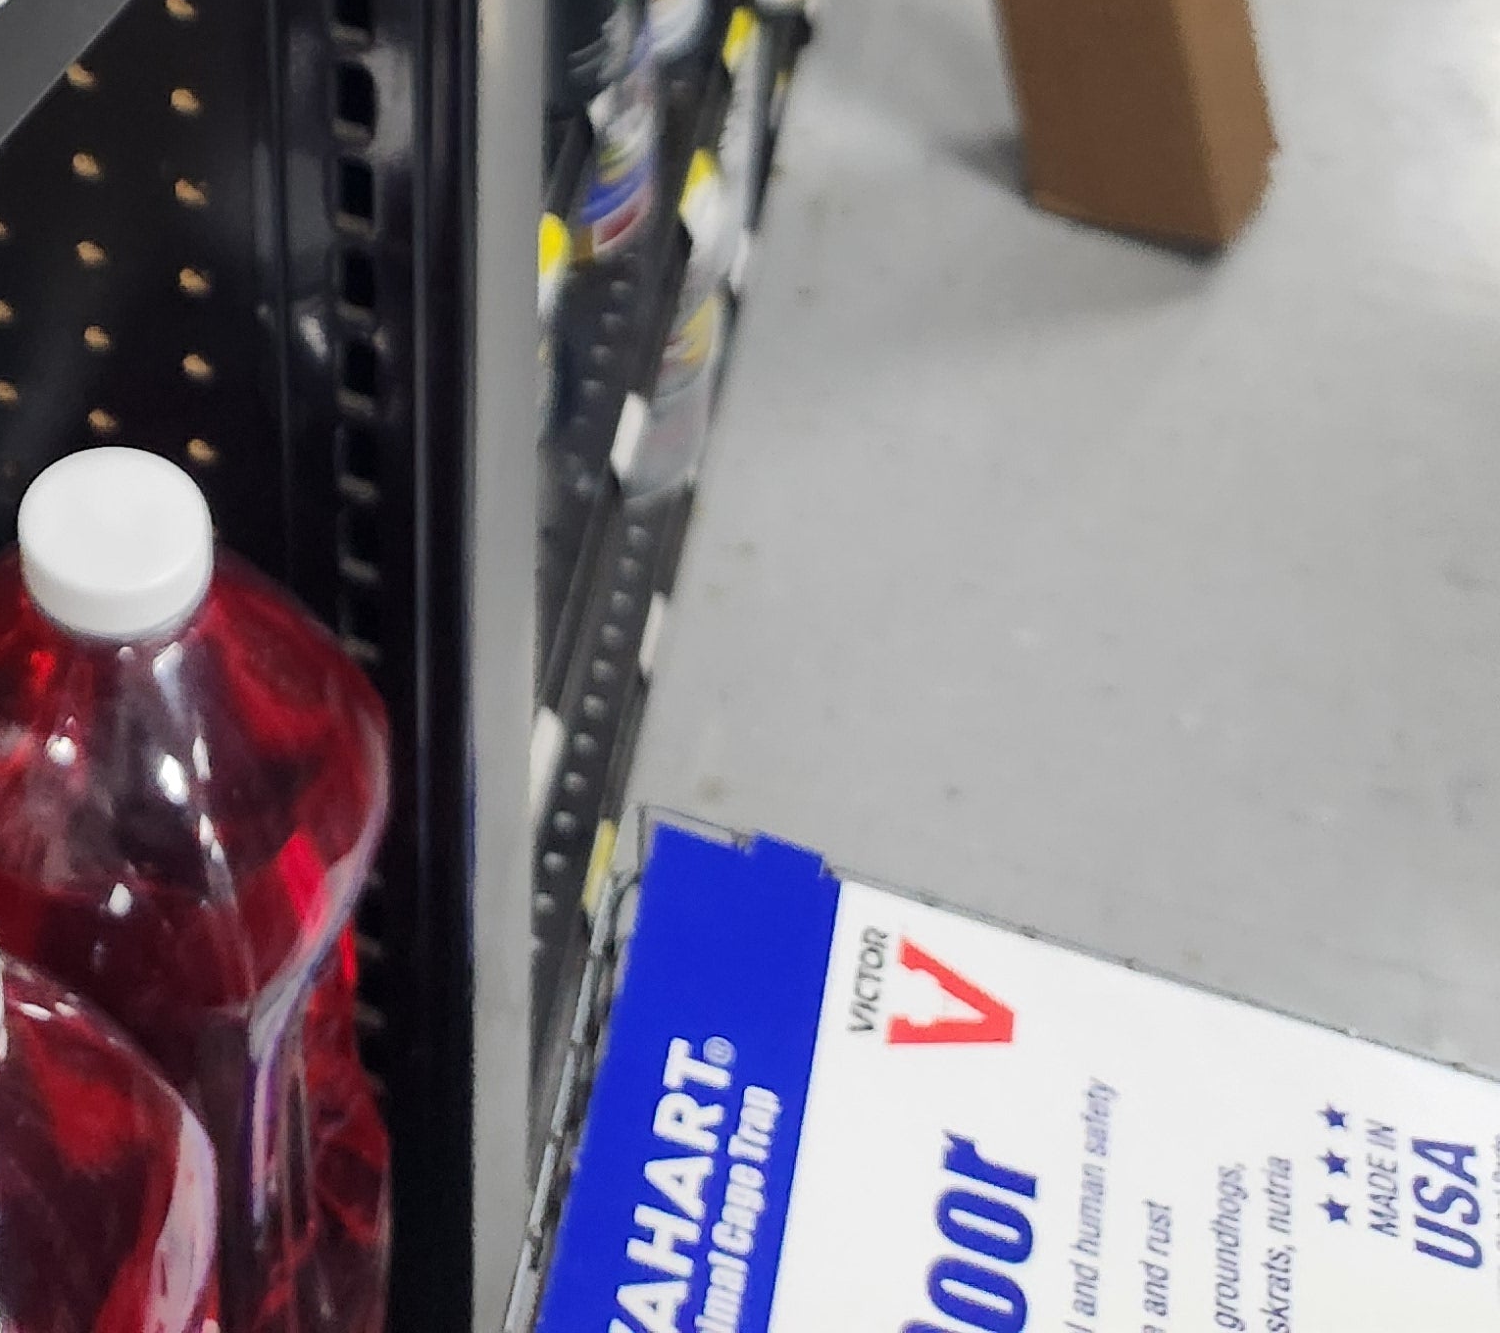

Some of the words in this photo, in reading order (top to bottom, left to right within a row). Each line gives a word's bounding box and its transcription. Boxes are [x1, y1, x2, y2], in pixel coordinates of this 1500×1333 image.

[847, 925, 889, 1034] VICTOR
[726, 1084, 783, 1164] Trap
[1080, 1075, 1120, 1157] safety
[1364, 1118, 1398, 1151] IN
[711, 1162, 766, 1256] Cage
[900, 1129, 1040, 1333] oor
[1069, 1163, 1105, 1258] human
[1143, 1198, 1172, 1257] rust
[1262, 1155, 1292, 1235] nutria
[1366, 1152, 1400, 1238] MADE
[1411, 1136, 1484, 1270] USA
[1068, 1258, 1100, 1318] and
[1139, 1259, 1170, 1318] and
[1209, 1162, 1249, 1332] groundhogs,
